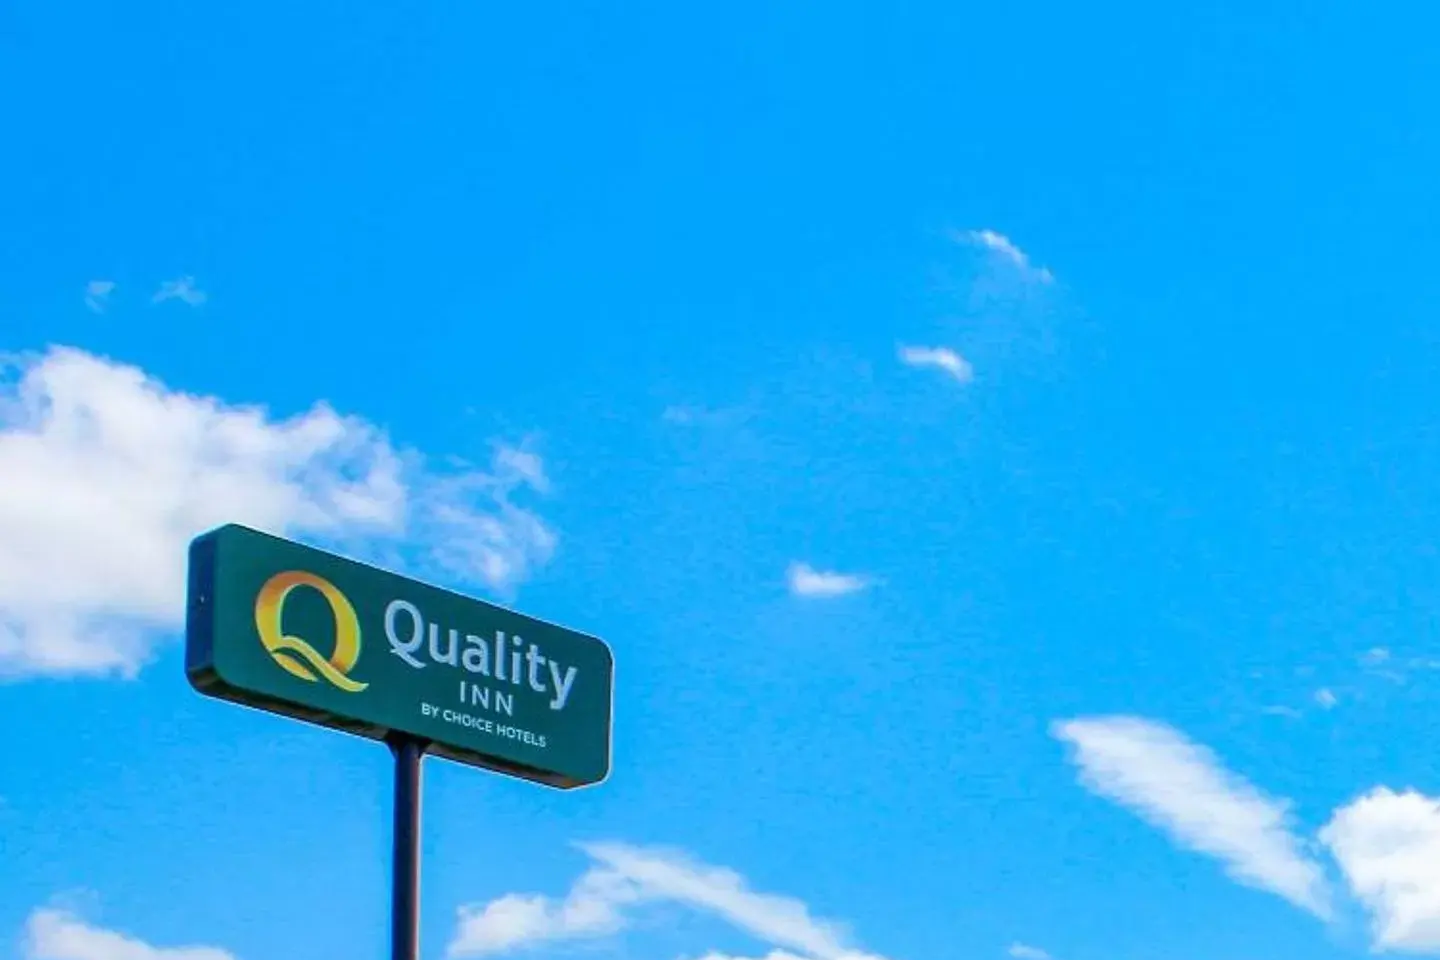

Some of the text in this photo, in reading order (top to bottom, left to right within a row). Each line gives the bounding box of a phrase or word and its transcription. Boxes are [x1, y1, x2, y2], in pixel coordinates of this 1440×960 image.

[255, 570, 369, 692] Q
[384, 599, 579, 710] Quality
[421, 702, 547, 748] BY CHOICE HOTELS
[460, 680, 514, 717] INN
